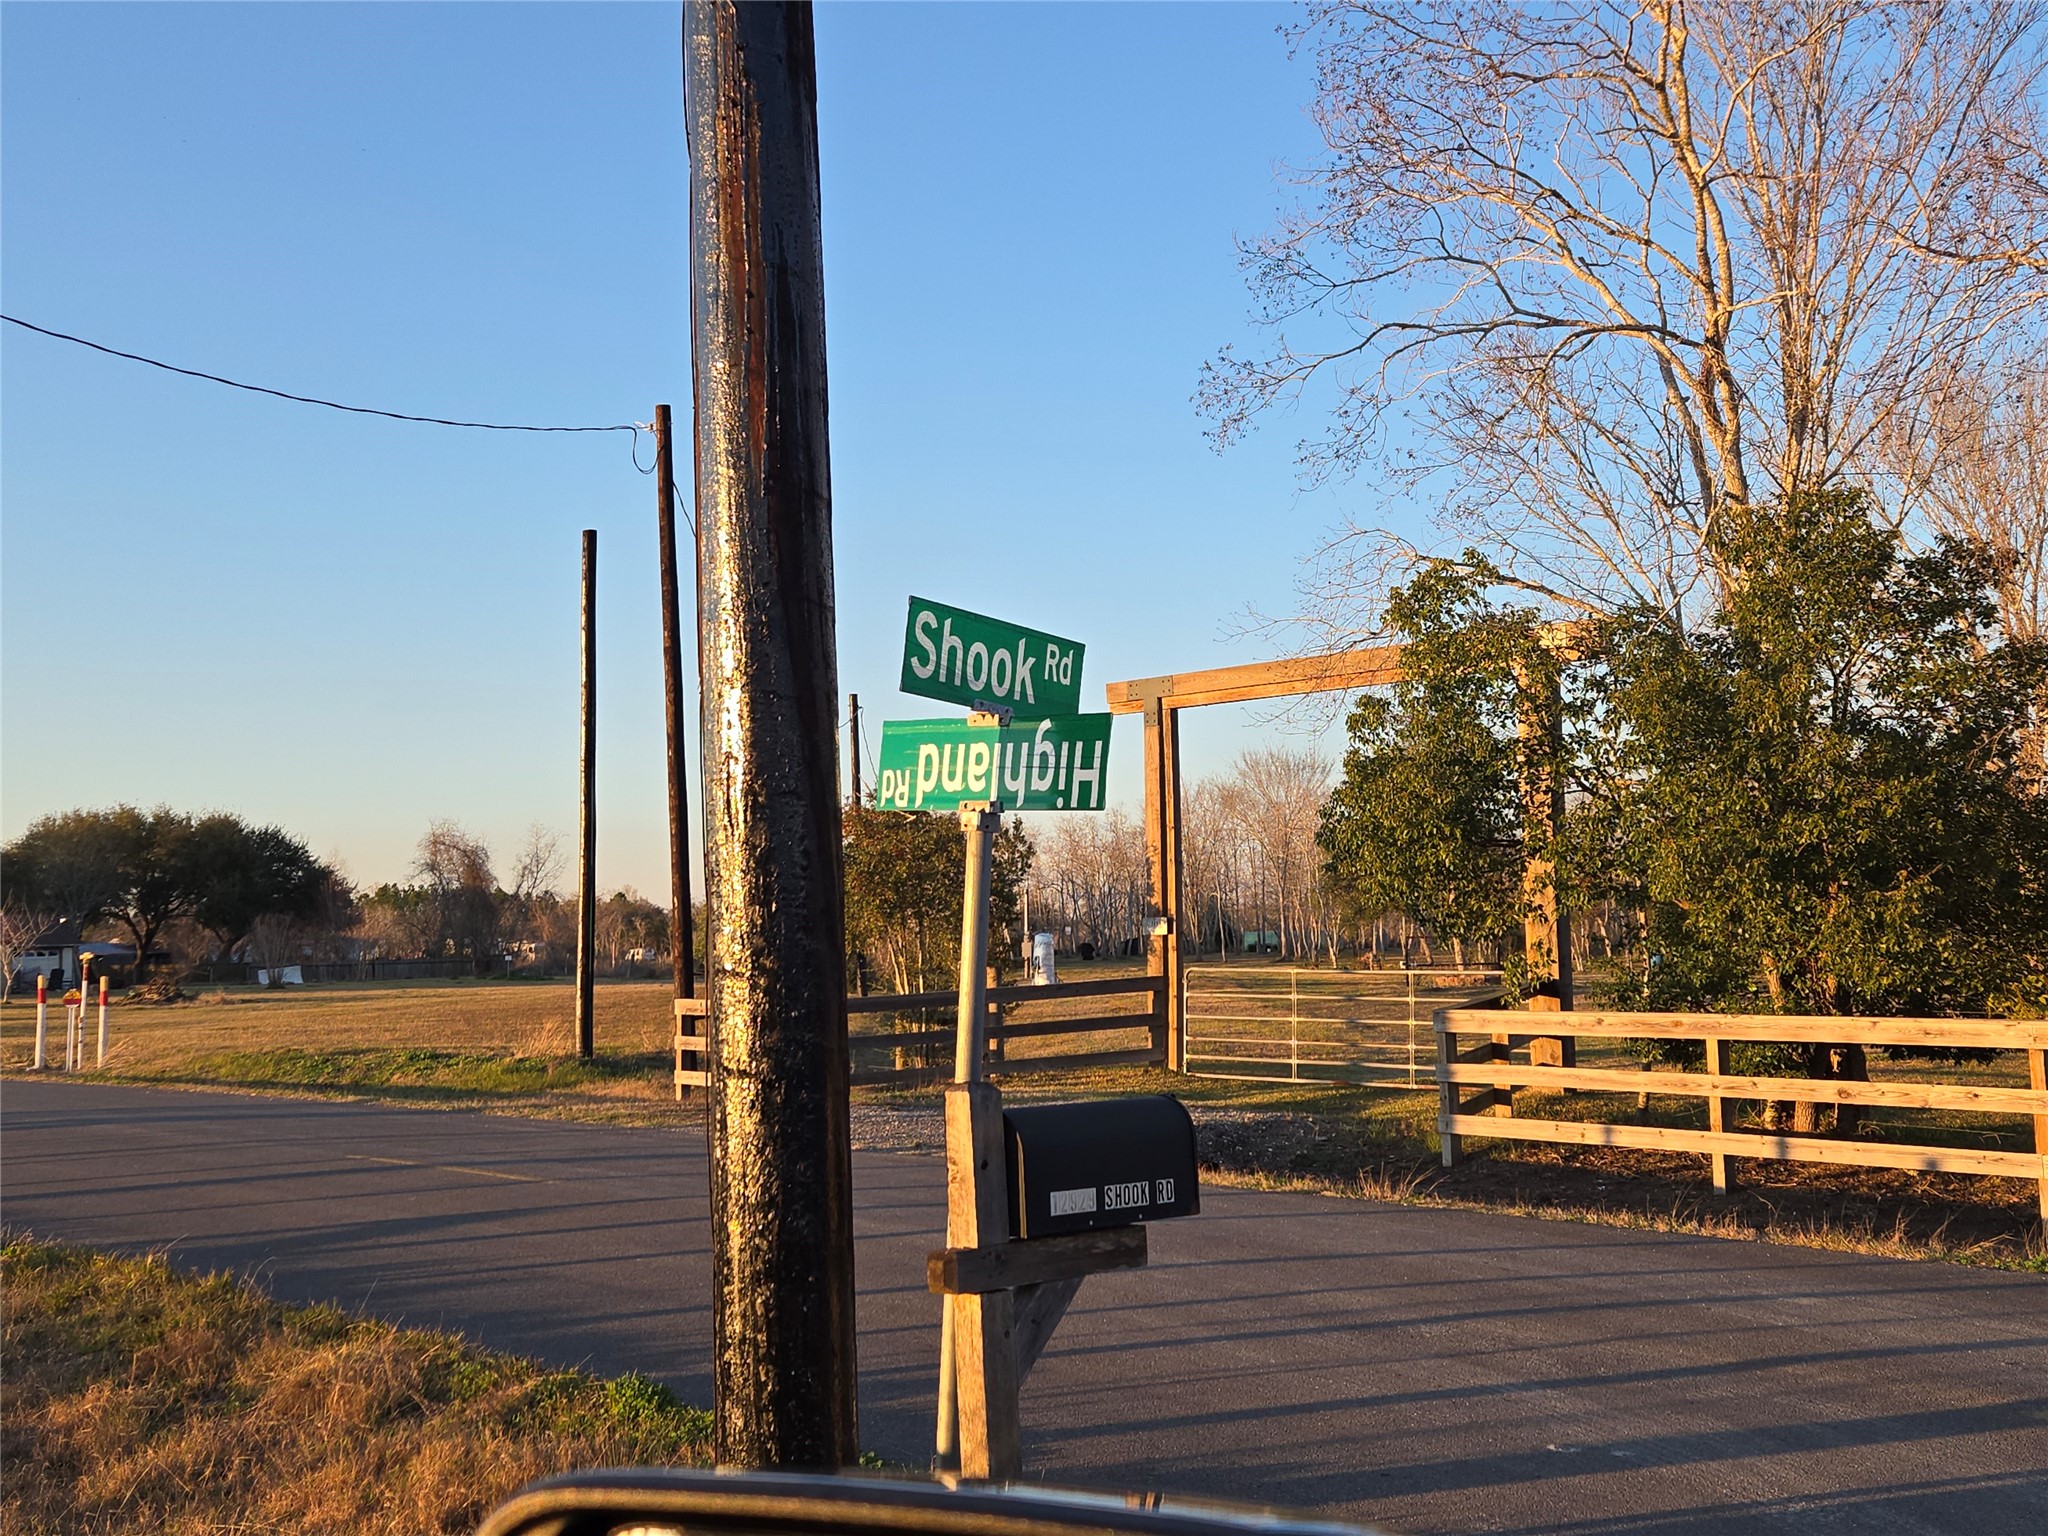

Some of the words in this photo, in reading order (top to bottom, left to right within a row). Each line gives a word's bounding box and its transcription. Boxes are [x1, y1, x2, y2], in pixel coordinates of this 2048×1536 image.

[911, 610, 1036, 704] Shook
[1044, 643, 1073, 685] Rd
[880, 769, 911, 807] Rd
[915, 718, 1102, 808] Highland
[1105, 1181, 1149, 1208] SHOOK
[1157, 1180, 1174, 1203] RD
